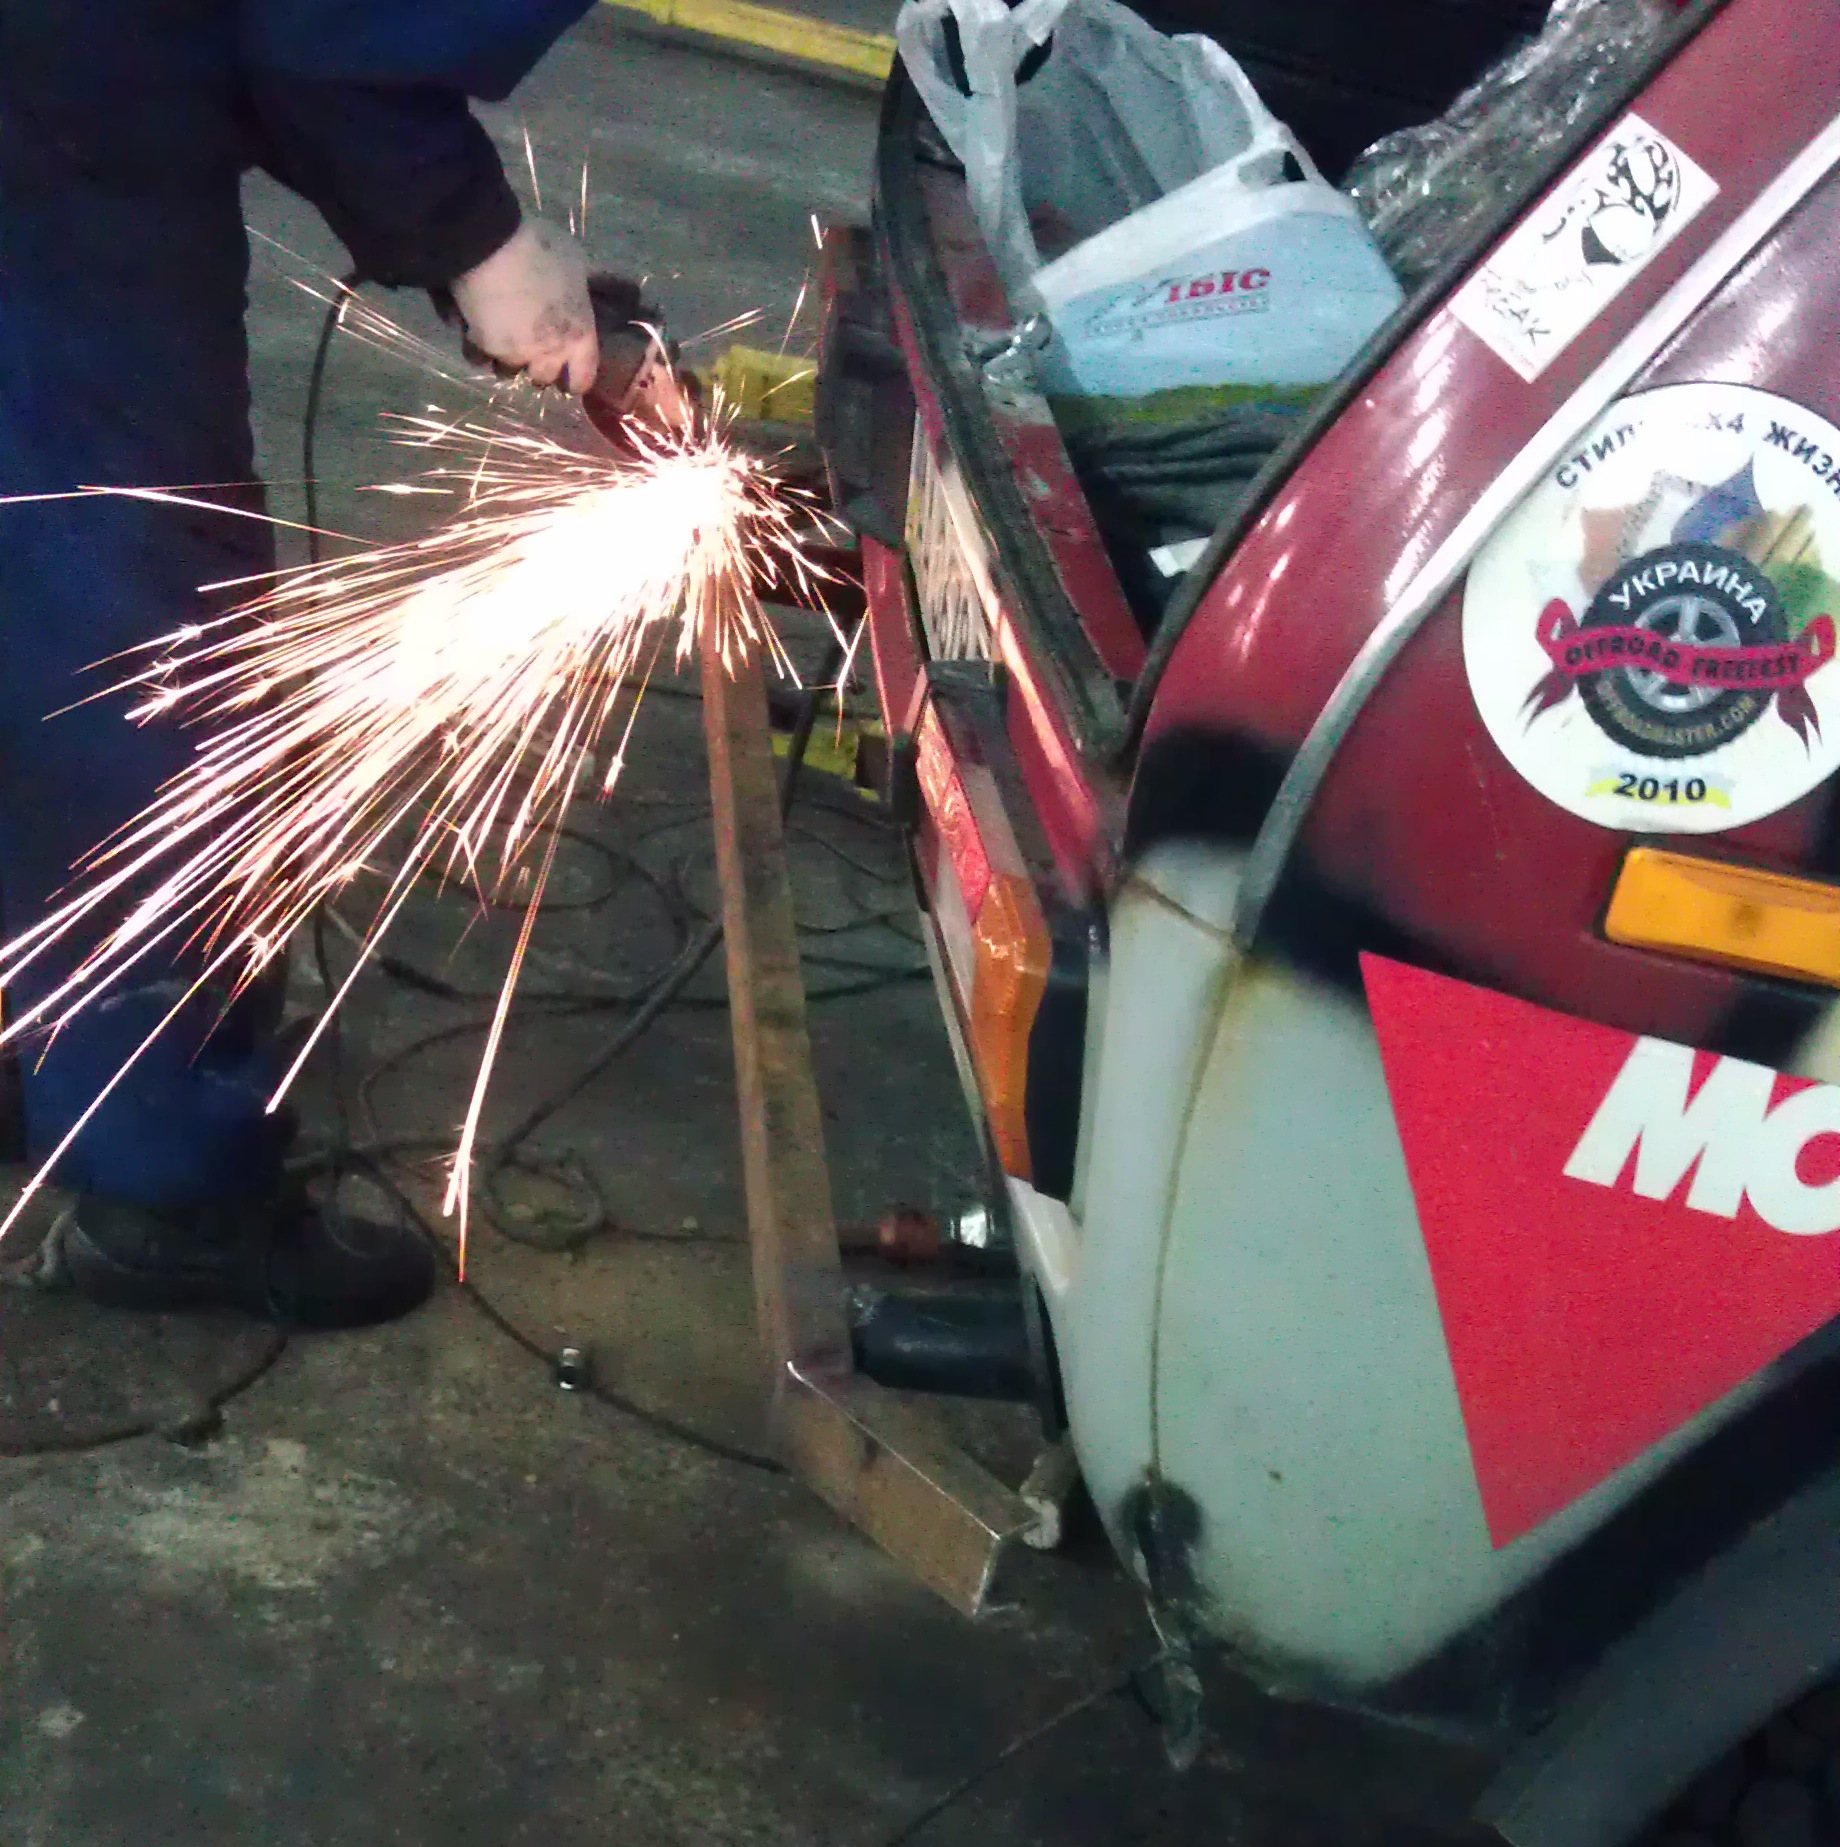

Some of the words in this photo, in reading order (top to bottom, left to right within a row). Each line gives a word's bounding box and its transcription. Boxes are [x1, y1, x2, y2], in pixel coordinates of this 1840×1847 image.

[1556, 421, 1643, 487] СТИЛ
[1608, 560, 1767, 624] УКРАИНА
[1613, 773, 1707, 802] 2010
